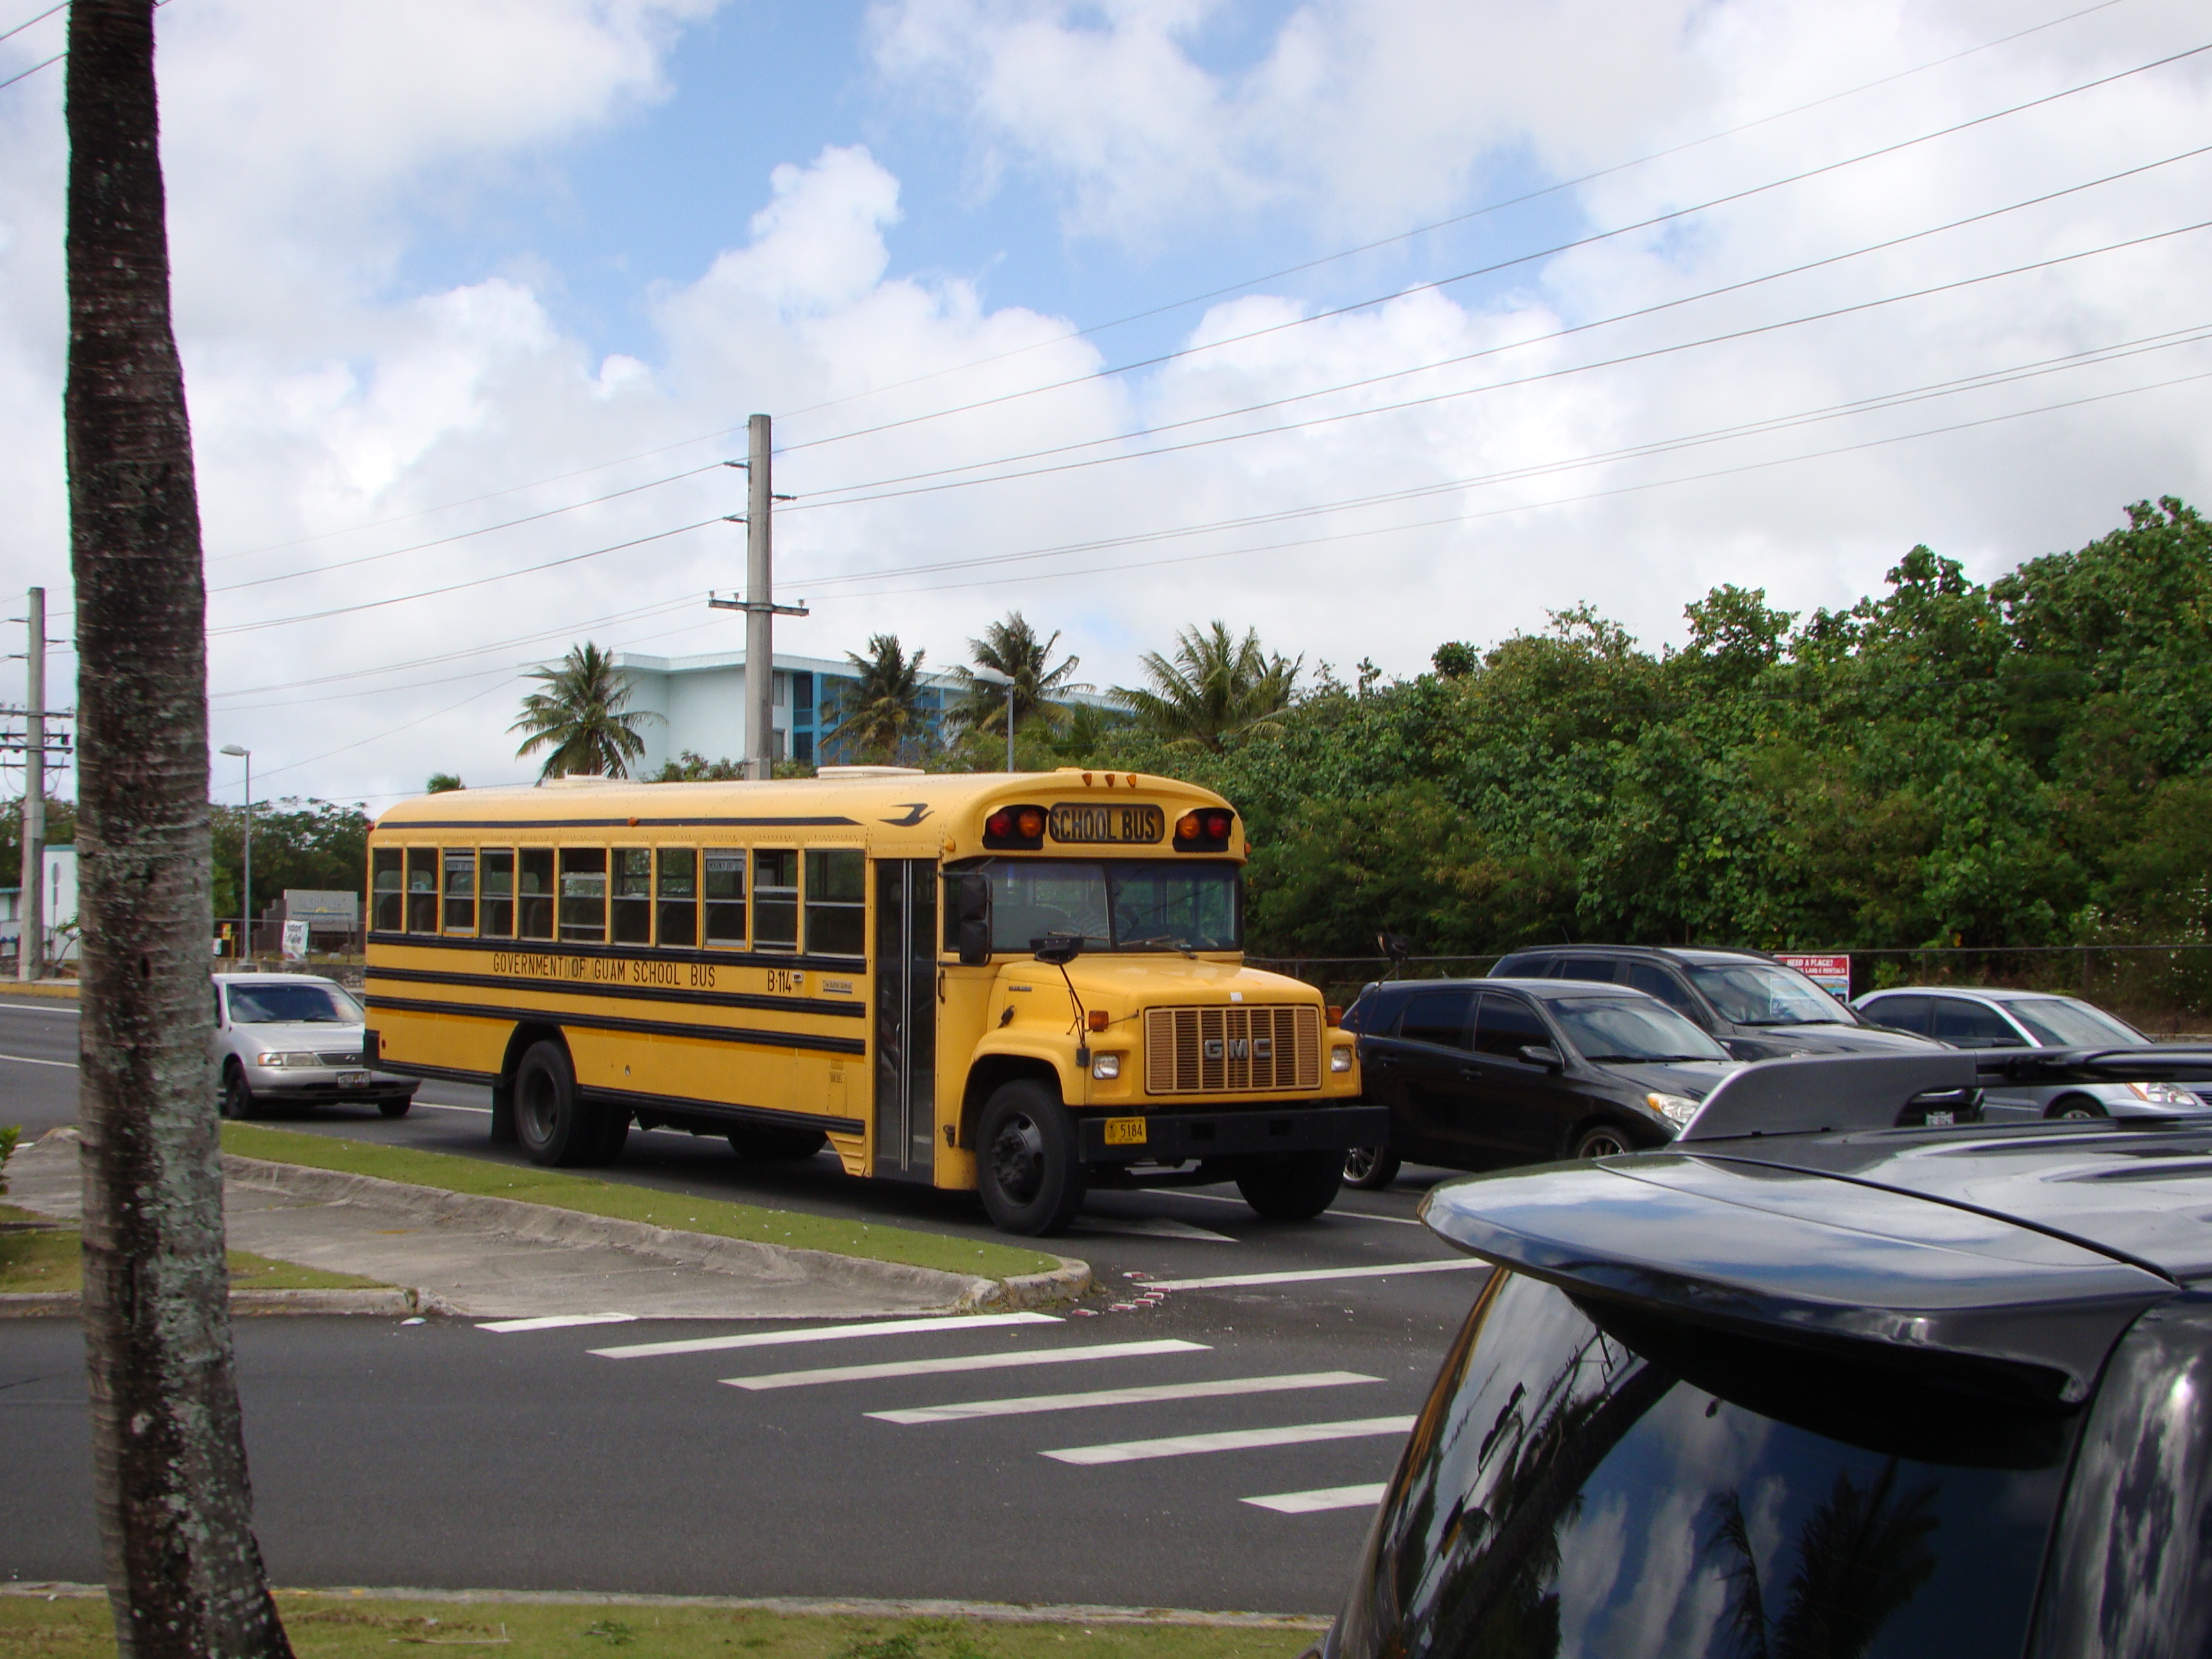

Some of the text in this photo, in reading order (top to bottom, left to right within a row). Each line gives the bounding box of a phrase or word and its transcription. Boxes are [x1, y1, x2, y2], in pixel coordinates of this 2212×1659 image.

[1050, 809, 1155, 840] SCHOOL BUS
[493, 952, 716, 988] GOVERNMENT OF GUAM SCHOOL BUS
[1787, 958, 1834, 967] NEED A PLACE?
[1205, 1039, 1271, 1060] GMC
[1120, 1123, 1142, 1138] 5184
